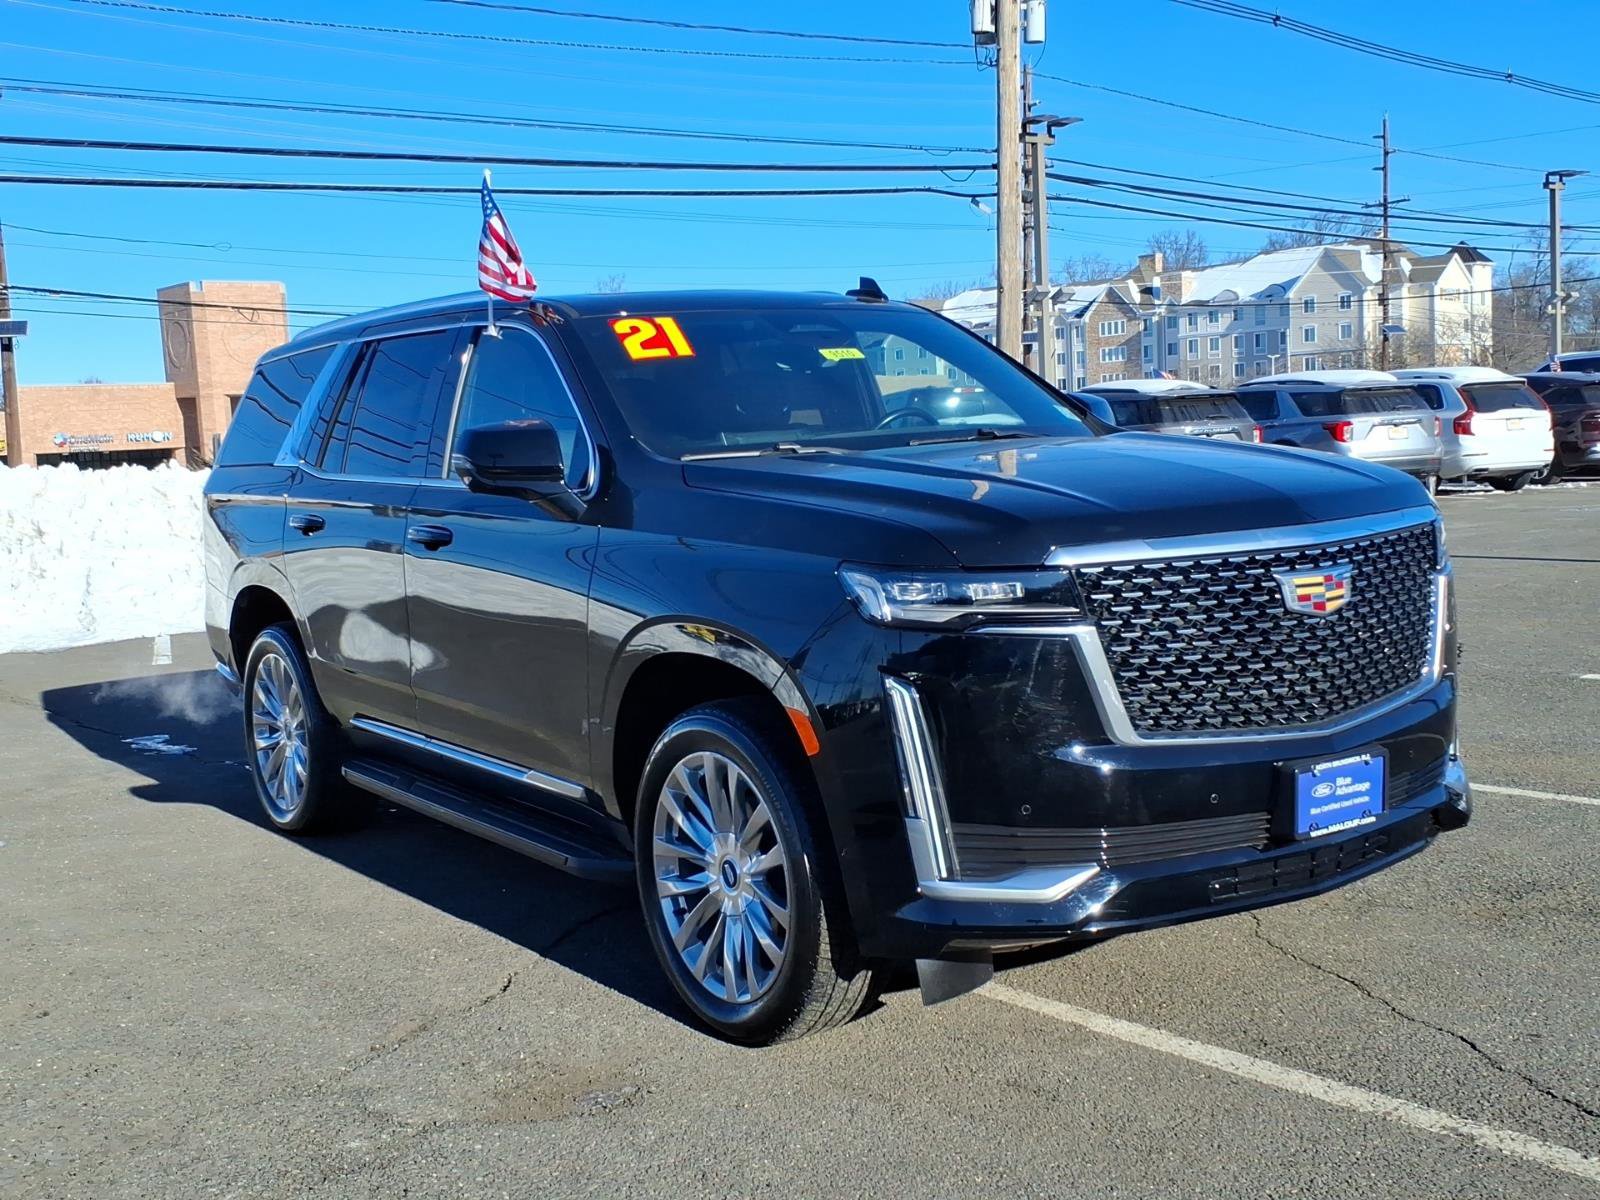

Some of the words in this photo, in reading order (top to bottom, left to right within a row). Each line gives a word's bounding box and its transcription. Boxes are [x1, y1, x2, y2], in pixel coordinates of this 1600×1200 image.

[612, 317, 694, 360] 21
[1335, 782, 1371, 795] Advantage
[1336, 777, 1352, 787] Blue
